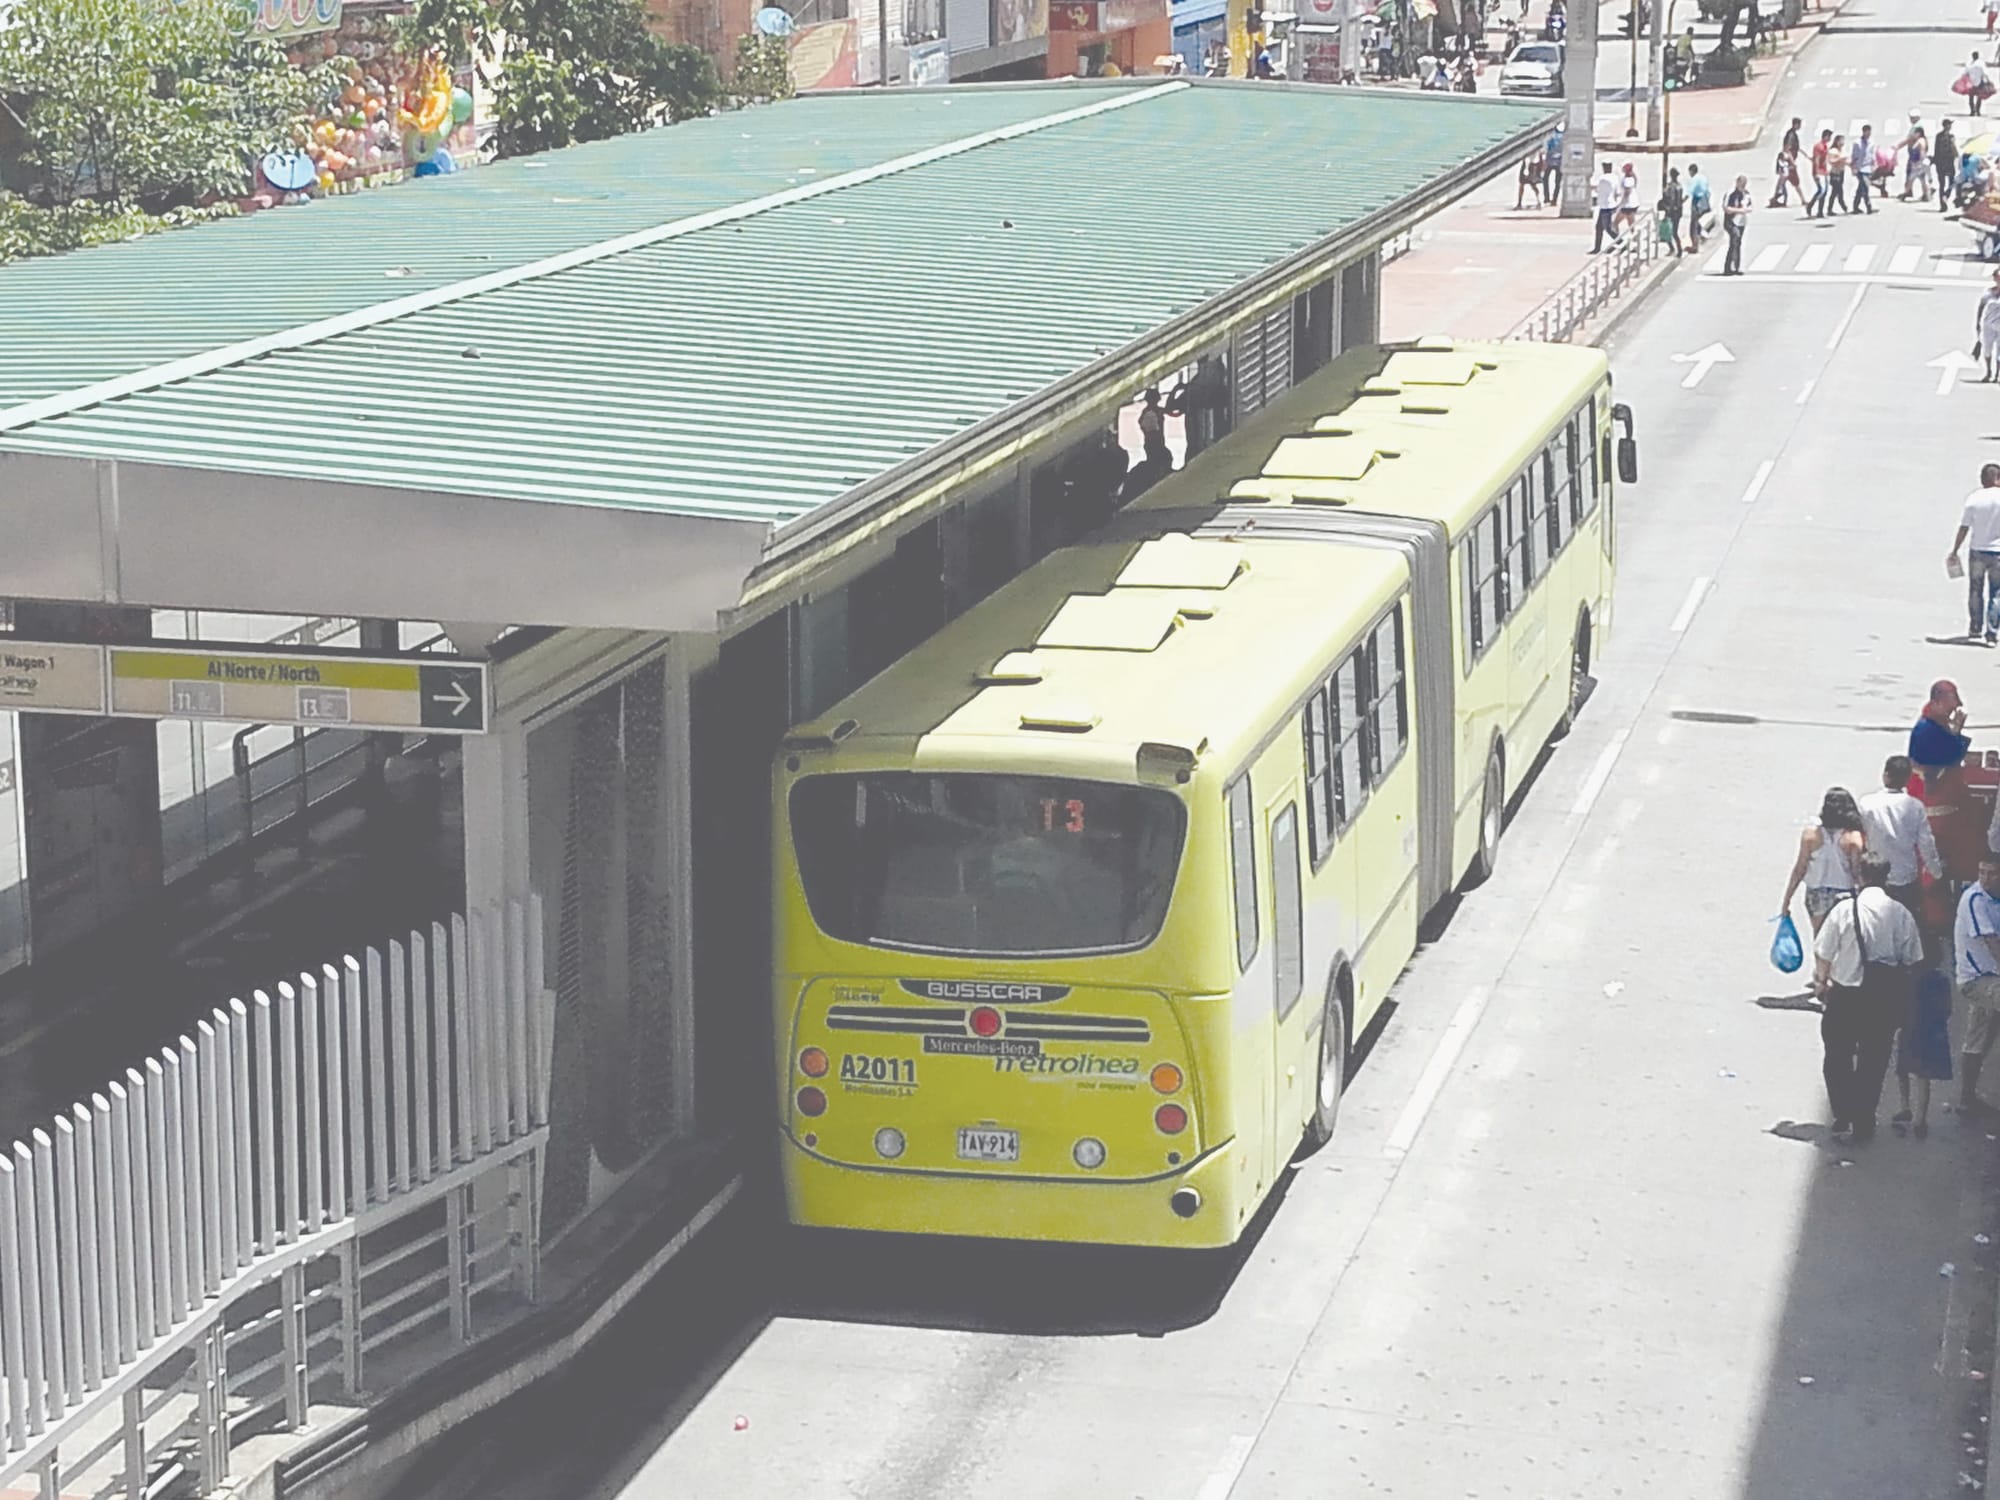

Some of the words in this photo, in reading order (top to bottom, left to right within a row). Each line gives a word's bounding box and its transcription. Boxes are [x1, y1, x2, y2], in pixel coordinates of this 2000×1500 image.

[4, 655, 46, 672] Wagon
[223, 662, 265, 680] Norte
[278, 664, 320, 682] North
[927, 981, 1042, 1001] BUSSCAR
[929, 1037, 1035, 1056] Mercedes-Benz
[840, 1054, 915, 1082] A2011
